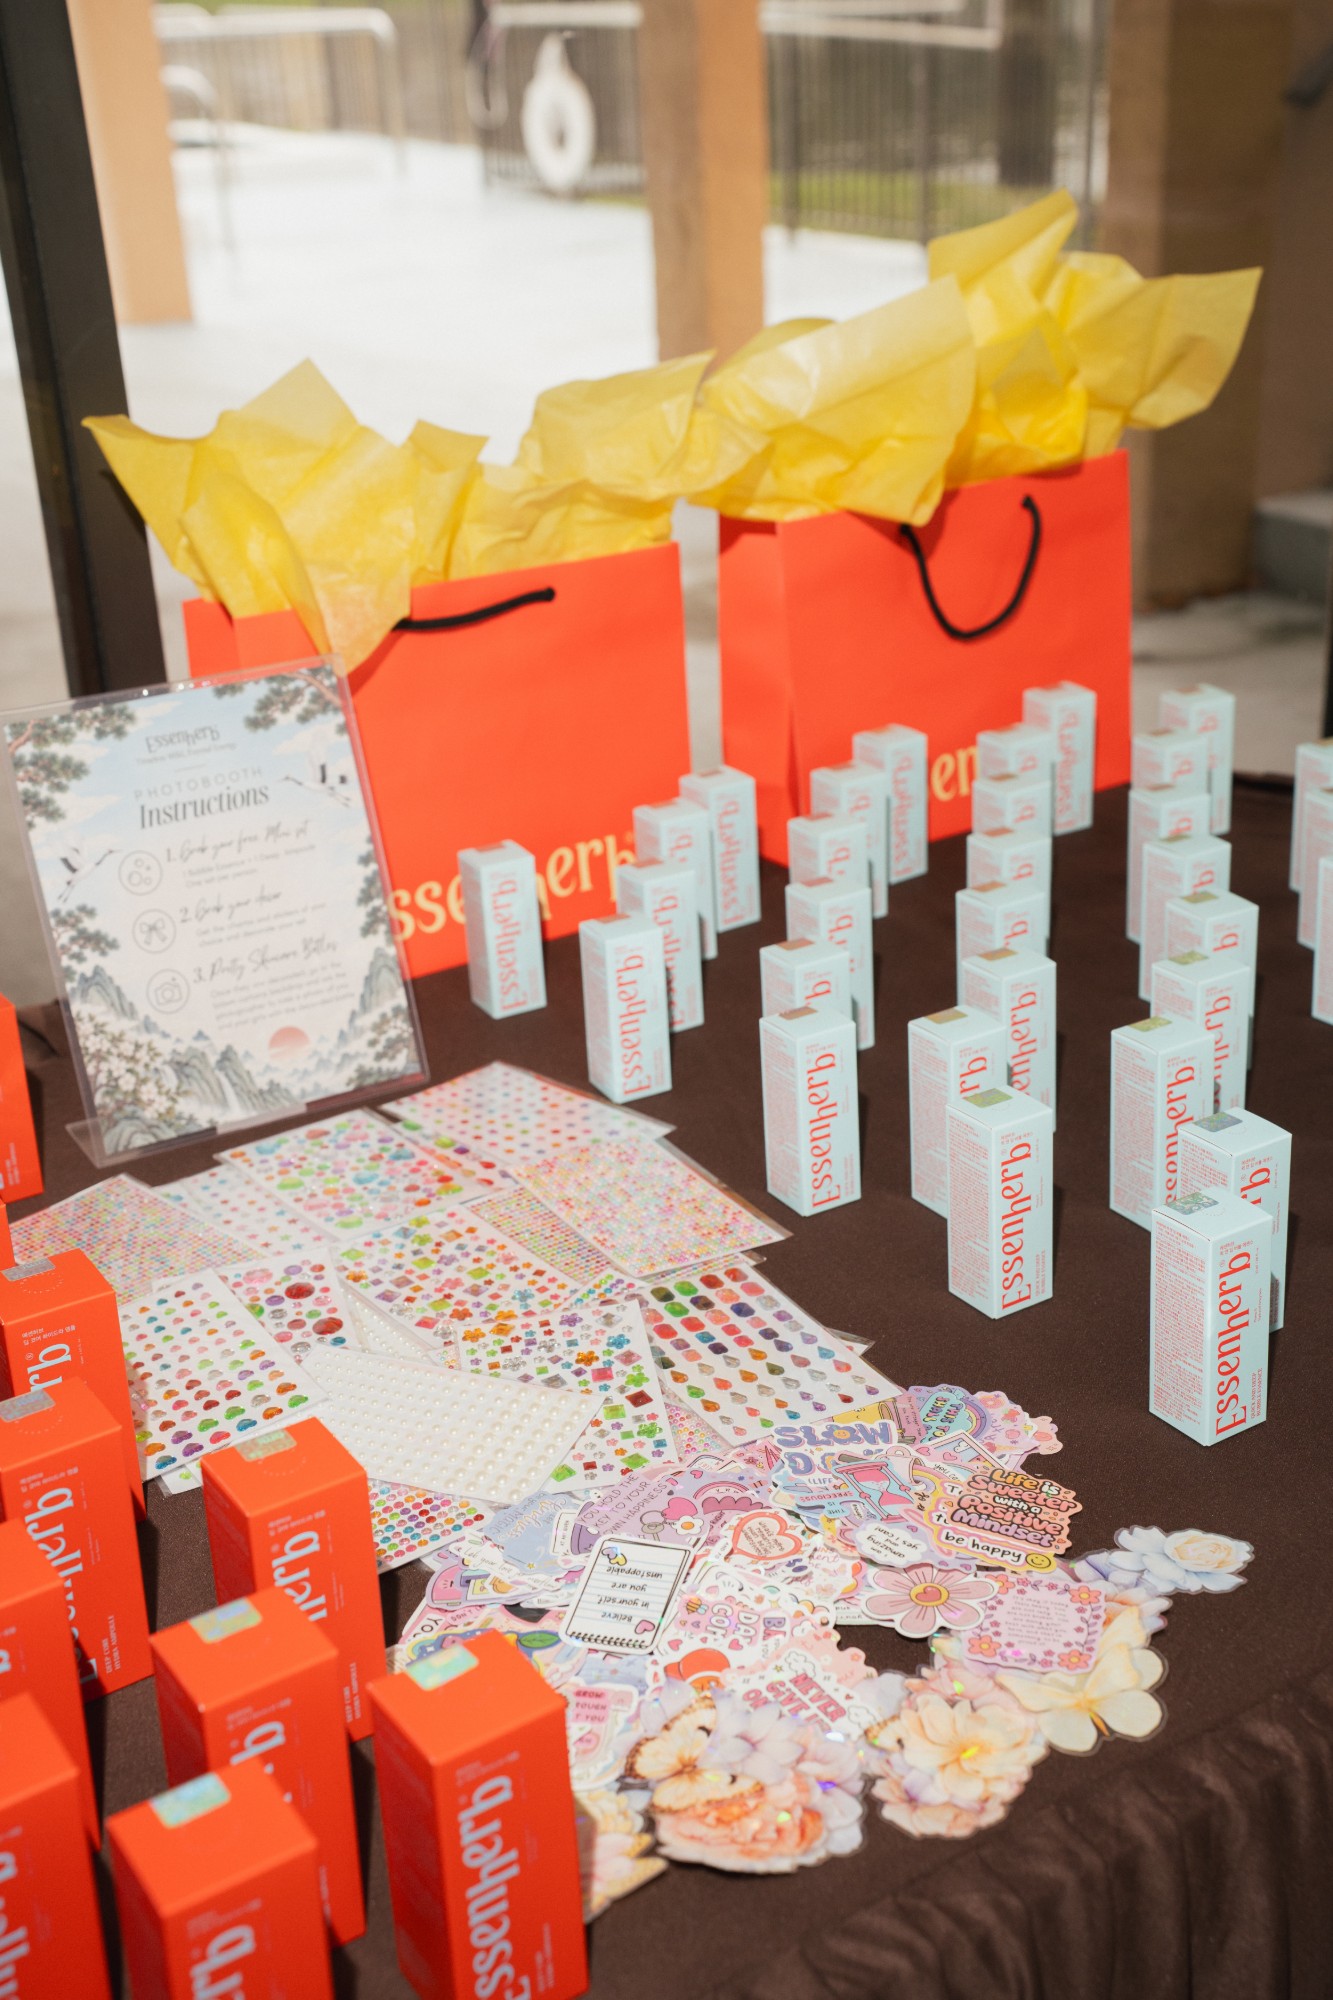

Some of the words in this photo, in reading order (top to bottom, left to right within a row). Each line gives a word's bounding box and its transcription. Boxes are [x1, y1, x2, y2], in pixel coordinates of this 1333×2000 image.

[145, 725, 221, 754] Essenherb
[134, 767, 262, 800] PHOTOBOOTH
[140, 785, 269, 830] Instructions
[615, 952, 653, 1096] Essenherb
[807, 1051, 842, 1209] Essenherb
[1001, 1142, 1032, 1310] Essenherb
[1216, 1252, 1251, 1436] Essenherb
[579, 1509, 600, 1523] YOU
[597, 1489, 622, 1508] HOLD
[619, 1474, 640, 1488] THE
[967, 1474, 1077, 1513] Sweeter
[990, 1468, 1039, 1490] Life
[1040, 1481, 1061, 1496] is
[593, 1514, 612, 1528] KEY
[611, 1502, 627, 1513] TO
[623, 1481, 651, 1502] YOUR
[602, 1520, 627, 1535] OWN
[623, 1483, 668, 1521] HAPPINESS
[957, 1494, 1064, 1536] Positive
[993, 1495, 1028, 1511] with
[1028, 1504, 1042, 1515] a
[866, 1534, 906, 1559] amazing
[902, 1540, 919, 1550] yes
[951, 1508, 1056, 1548] Mindset
[944, 1532, 965, 1546] be
[971, 1539, 1022, 1564] happy
[606, 1566, 663, 1579] unstoppable
[629, 1583, 648, 1592] you
[450, 1608, 473, 1622] DON'T
[601, 1611, 633, 1623] Believe
[766, 1680, 810, 1717] GIVE
[789, 1672, 847, 1723] NEVER
